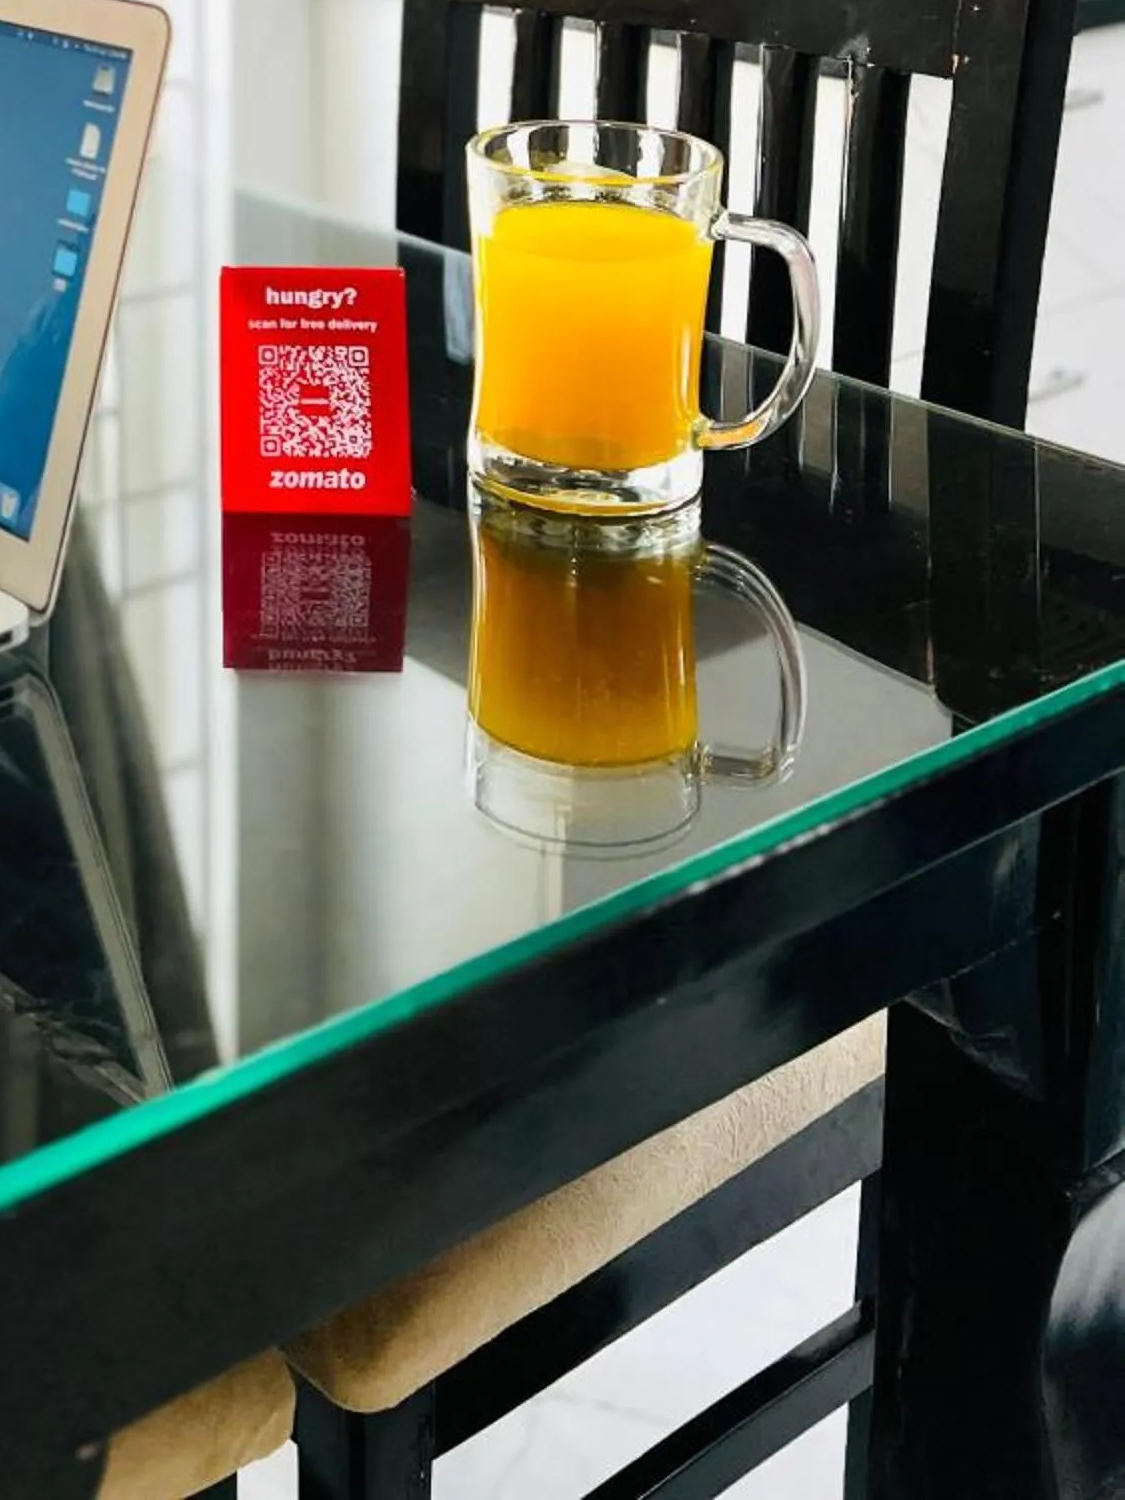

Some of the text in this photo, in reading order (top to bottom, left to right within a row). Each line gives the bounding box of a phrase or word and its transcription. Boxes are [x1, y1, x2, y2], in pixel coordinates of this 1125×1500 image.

[266, 286, 357, 309] hungry?
[248, 318, 378, 333] scan for free delivery
[270, 468, 366, 489] zomato
